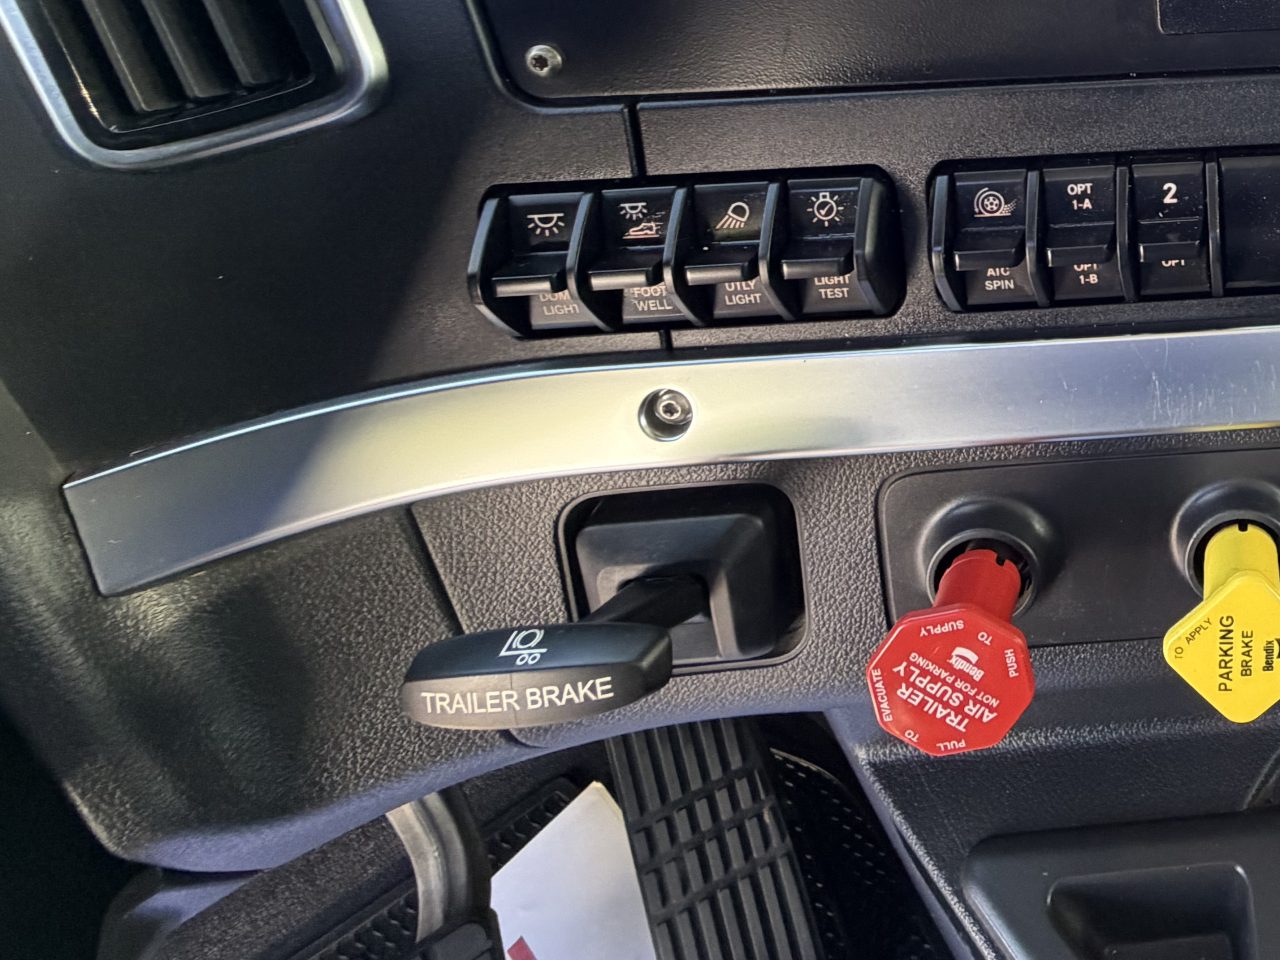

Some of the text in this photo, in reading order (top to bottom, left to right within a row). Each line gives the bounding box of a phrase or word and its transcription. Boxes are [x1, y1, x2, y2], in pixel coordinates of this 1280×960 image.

[1066, 183, 1093, 196] OPT
[1162, 182, 1178, 204] 2
[1072, 198, 1093, 210] 1-A
[632, 285, 668, 298] FOOT
[814, 274, 851, 286] LIGHT
[818, 287, 849, 299] TEST
[984, 279, 1015, 291] SPIN
[1079, 274, 1099, 285] 1-B
[635, 299, 674, 311] WELL
[725, 293, 762, 306] LIGHT
[1184, 617, 1213, 645] APPLY
[919, 619, 1020, 678] PUSH TO SUPPLY
[1217, 615, 1235, 692] PARKING
[1240, 630, 1254, 677] BRAKE
[1262, 639, 1275, 672] Bendix
[908, 651, 1000, 708] NOT FOR PARKING
[949, 654, 985, 682] Bendix
[420, 676, 615, 714] TRAILER BRAKE
[892, 661, 998, 723] AIR SUPPLY
[871, 667, 967, 752] PULL TO EVACUATE
[896, 682, 970, 732] TRAILER
